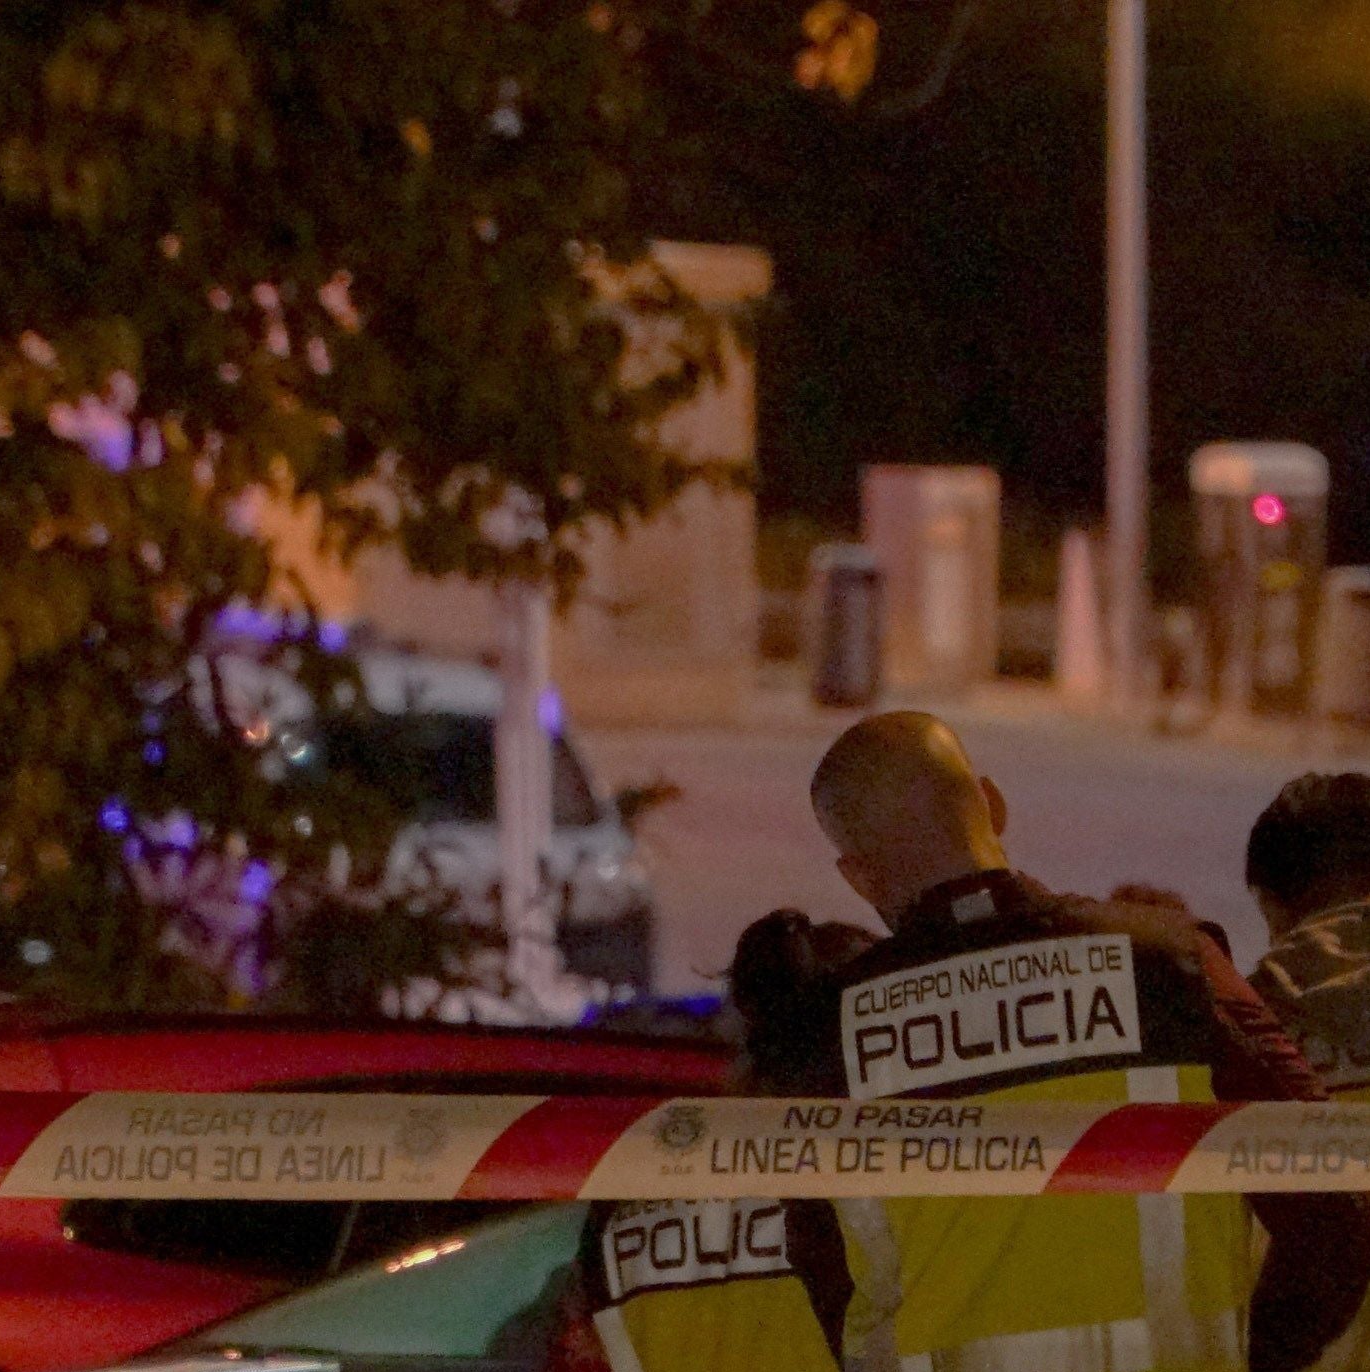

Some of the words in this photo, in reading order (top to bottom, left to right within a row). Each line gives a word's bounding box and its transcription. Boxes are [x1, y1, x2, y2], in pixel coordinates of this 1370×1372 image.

[854, 972, 952, 1017] CUERPO
[959, 949, 1082, 994] NACIONAL
[1088, 945, 1122, 973] DE
[855, 986, 1126, 1084] POLICIA
[784, 1105, 840, 1129] NO
[853, 1105, 985, 1129] PASAR
[711, 1137, 819, 1174] LINEA
[836, 1136, 885, 1173] DE
[900, 1136, 1045, 1173] POLICIA
[614, 1205, 782, 1288] POLIC
